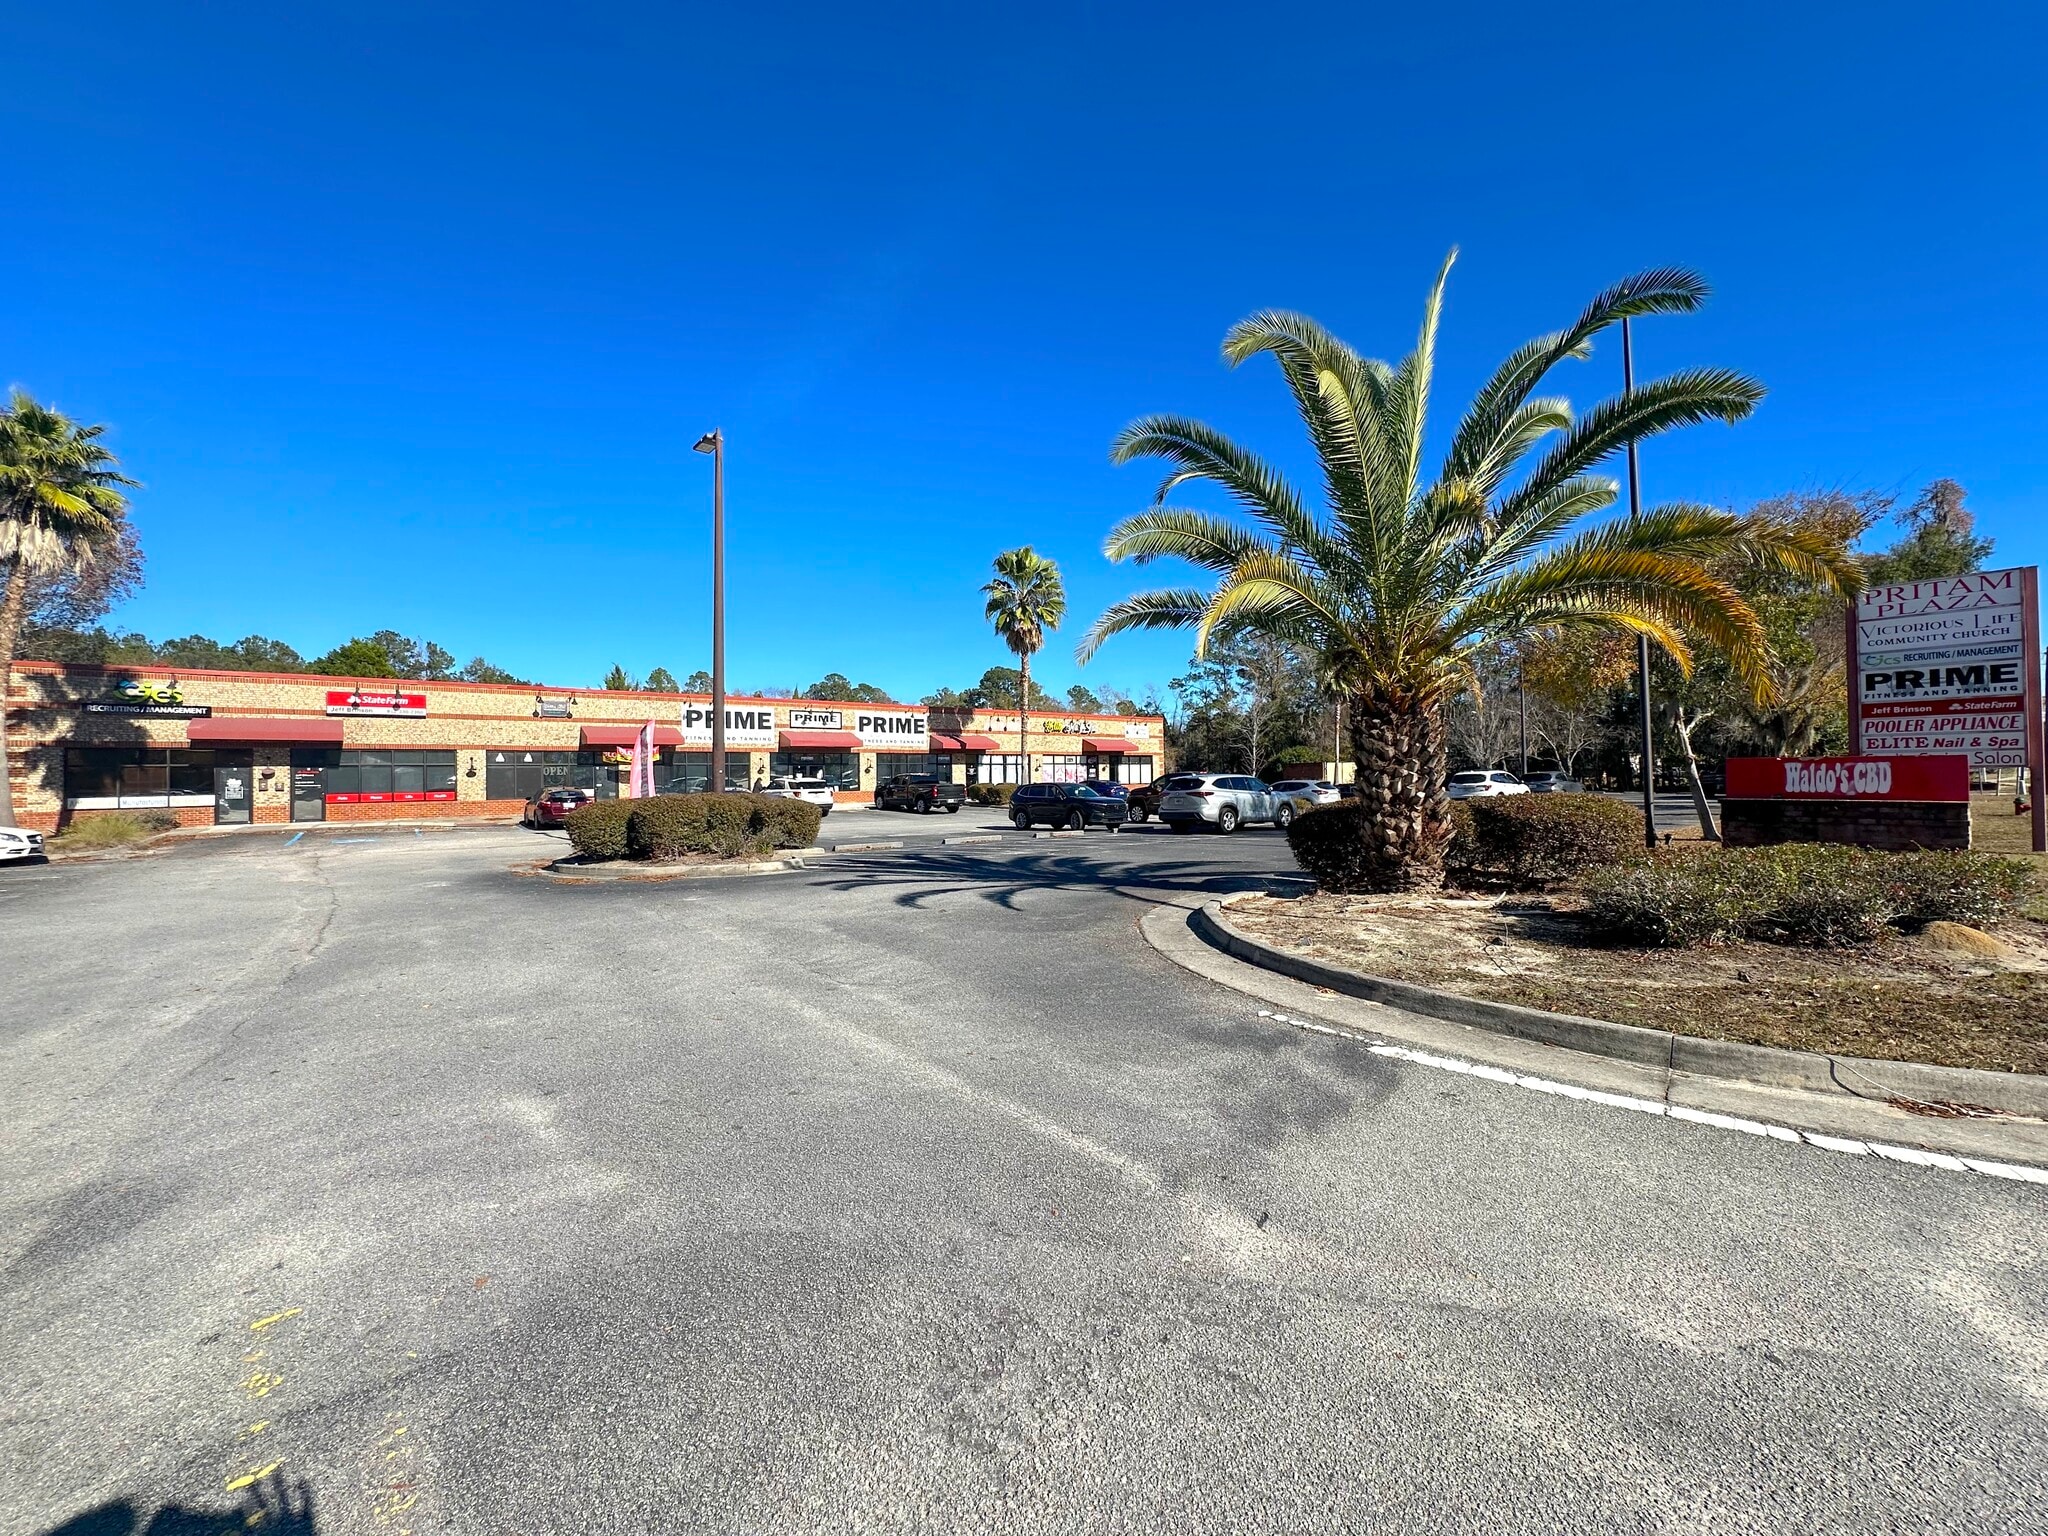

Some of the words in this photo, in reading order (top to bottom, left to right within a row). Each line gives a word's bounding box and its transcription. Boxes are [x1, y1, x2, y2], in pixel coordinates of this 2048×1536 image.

[1865, 571, 2015, 605] PRITAM
[1877, 593, 1998, 617] PLAZA
[1867, 633, 1948, 647] COMMUNITY
[1952, 627, 2011, 640] CHURCH
[1903, 650, 1950, 662] RECRUITING
[1956, 644, 2020, 658] MANAGEMENT
[1865, 663, 2019, 692] PRIME
[1864, 690, 1916, 700] FITNESS
[1922, 688, 1949, 697] AND
[1956, 685, 2018, 695] TANNING
[87, 704, 140, 713] RECRUITING
[145, 706, 208, 715] MANAGEMENT
[794, 714, 838, 723] PRIME
[1871, 706, 1891, 715] Jeff
[1893, 705, 1933, 714] Brinson
[858, 715, 925, 734] PRIME
[1864, 719, 1925, 734] POOLER
[1928, 715, 2022, 731] APPLIANCE
[1865, 737, 1929, 750] ELITE
[1933, 737, 1965, 748] Nail
[1969, 737, 1982, 747] &
[1987, 736, 2020, 749] Spa
[1974, 751, 2023, 765] Salon
[543, 765, 569, 776] OPEN
[1783, 761, 1849, 794] Waldo's
[1852, 761, 1892, 794] CBD
